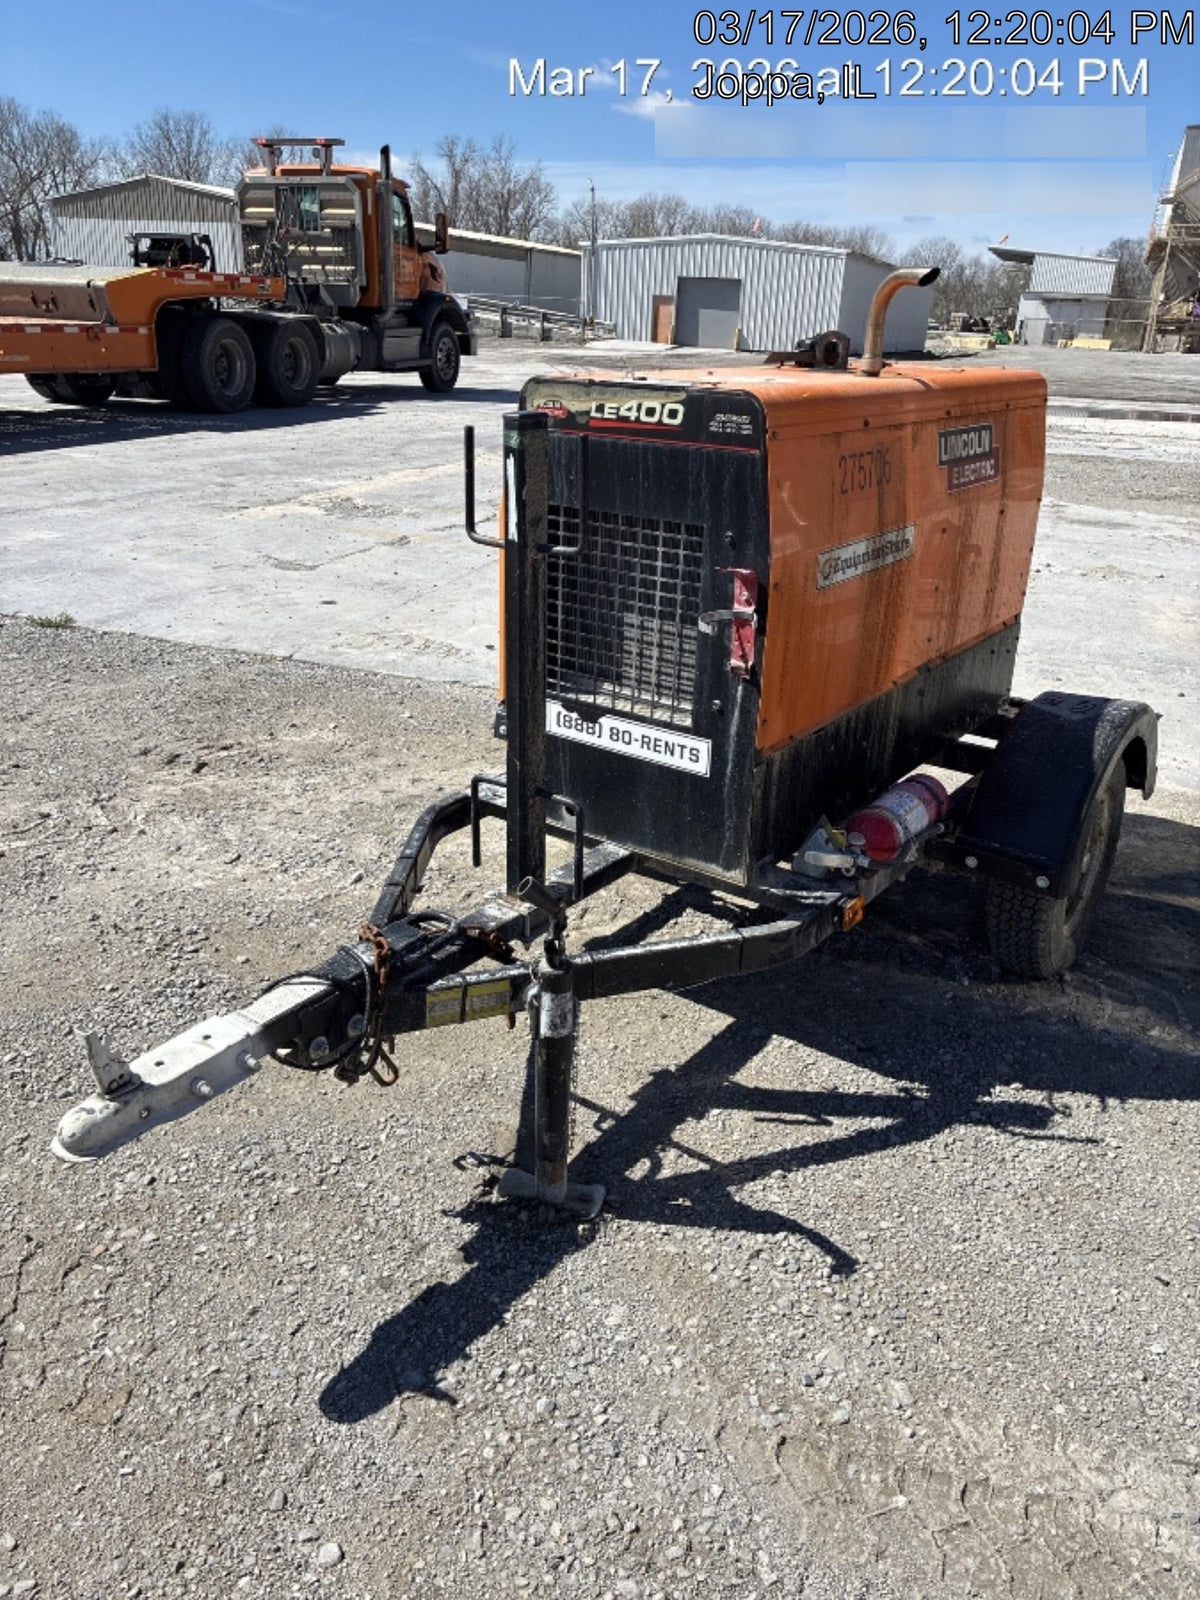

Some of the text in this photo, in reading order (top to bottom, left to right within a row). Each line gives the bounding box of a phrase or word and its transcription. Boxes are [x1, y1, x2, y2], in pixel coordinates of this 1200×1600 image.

[590, 401, 685, 426] LE400
[941, 429, 990, 461] LINCOLN
[839, 447, 892, 495] 275706
[609, 726, 701, 764] 80-RENTS
